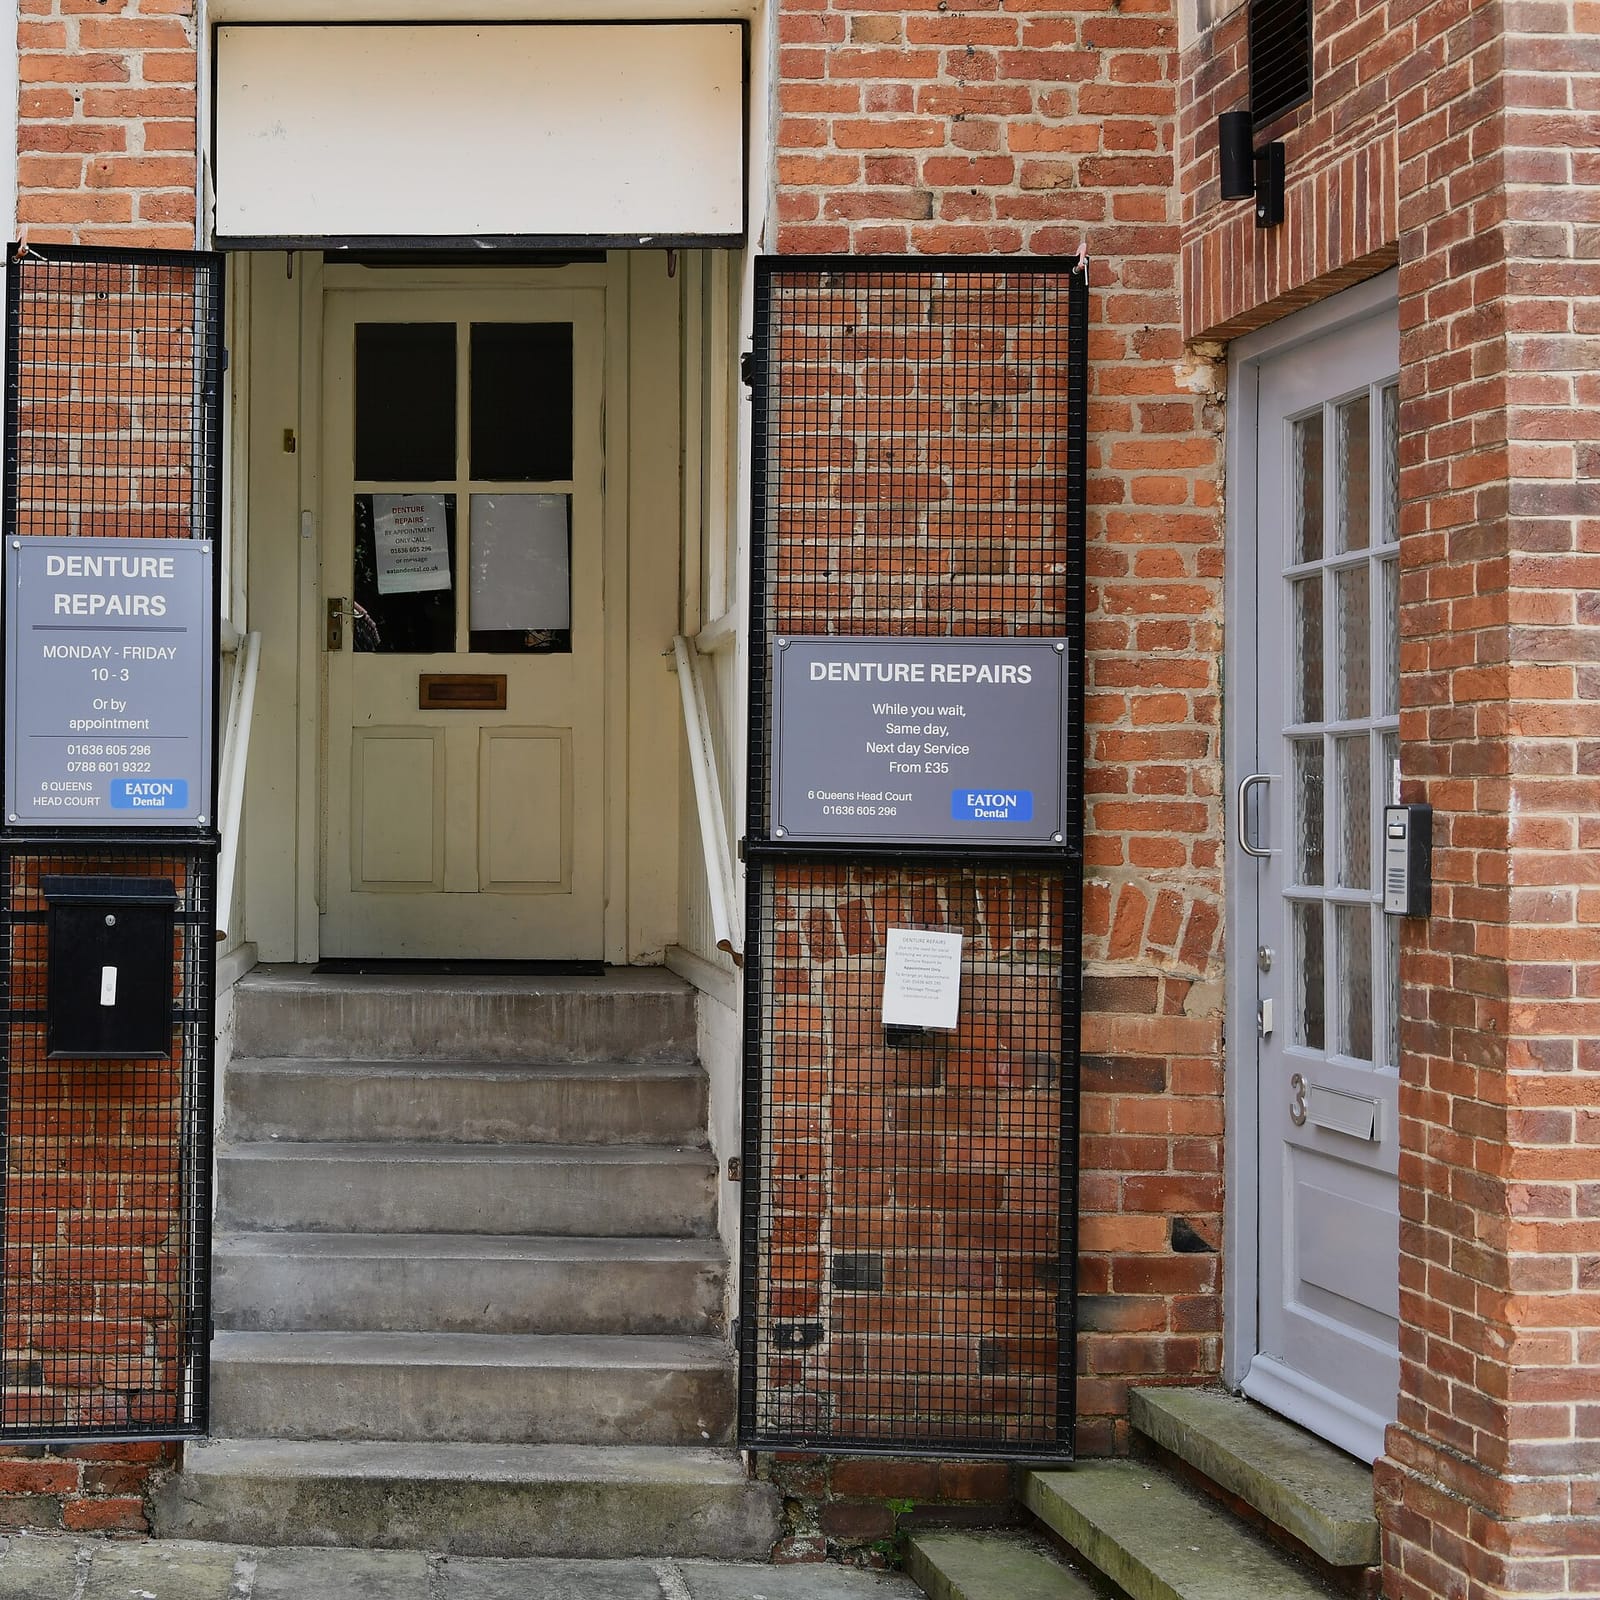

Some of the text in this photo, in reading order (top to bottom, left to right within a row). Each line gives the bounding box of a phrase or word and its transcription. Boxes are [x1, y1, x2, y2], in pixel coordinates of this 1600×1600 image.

[393, 527, 435, 535] APPOINTMENT
[47, 556, 174, 578] DENTURE
[54, 594, 166, 616] REPAIRS
[43, 646, 112, 659] MONDAY
[123, 647, 177, 660] FRIDAY
[91, 668, 109, 681] 10
[120, 668, 129, 681] 3
[810, 662, 1032, 684] DENTURE REPAIRS
[93, 699, 127, 713] Or by
[872, 703, 966, 718] While you wait,
[69, 718, 149, 732] appointment
[886, 723, 949, 737] Same day,
[67, 745, 151, 756] 01636 605 296
[867, 742, 969, 756] Next day Service
[67, 762, 151, 773] 0788 601 9322
[890, 761, 949, 774] From £35
[42, 782, 92, 791] 6 QUEENS
[125, 783, 173, 795] EATON
[33, 797, 101, 806] HEAD COURT
[133, 797, 165, 807] Dental
[808, 790, 912, 802] 6 Queens Head Court
[967, 794, 1017, 807] EATON
[823, 805, 897, 816] 01636 605 296
[975, 808, 1008, 818] Dental
[1289, 1072, 1307, 1127] 3
